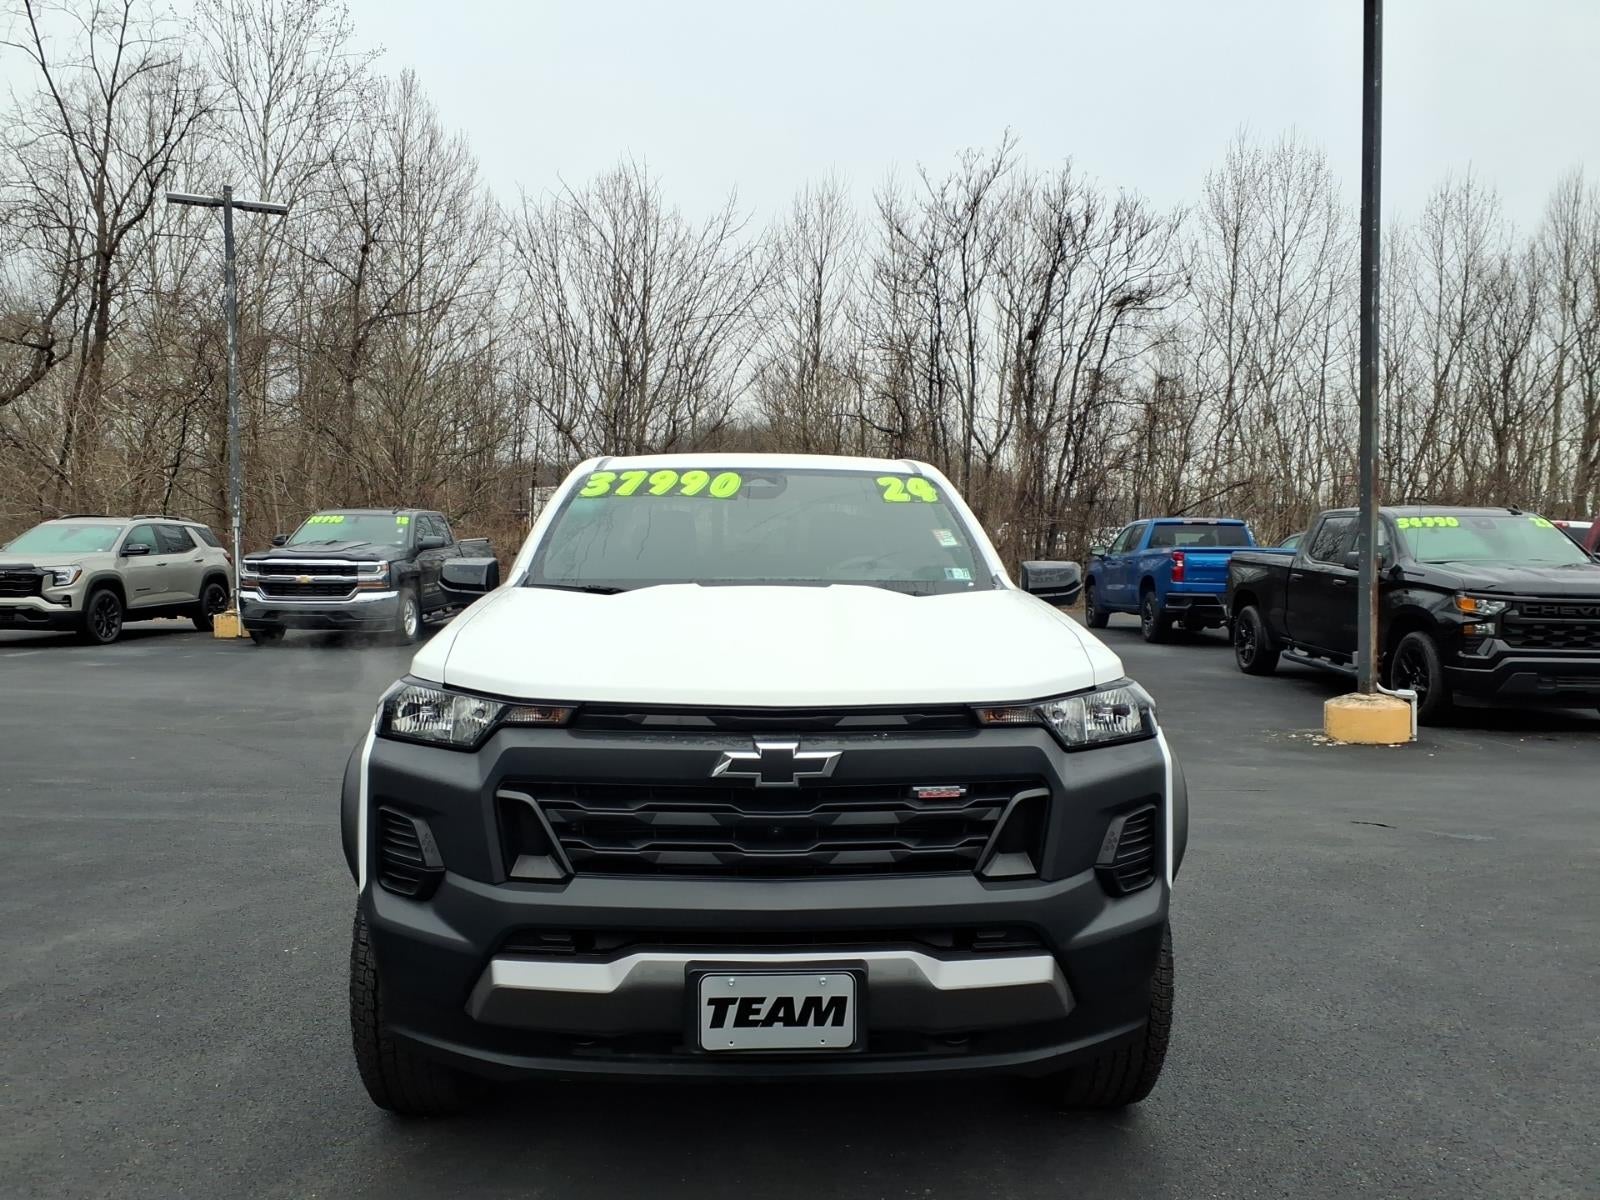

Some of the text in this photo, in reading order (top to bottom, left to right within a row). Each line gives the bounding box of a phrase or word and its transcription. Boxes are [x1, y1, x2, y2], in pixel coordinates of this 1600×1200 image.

[579, 470, 742, 498] 37990
[876, 476, 938, 502] 24
[1522, 604, 1600, 616] CHEV
[706, 995, 849, 1029] TEAM
